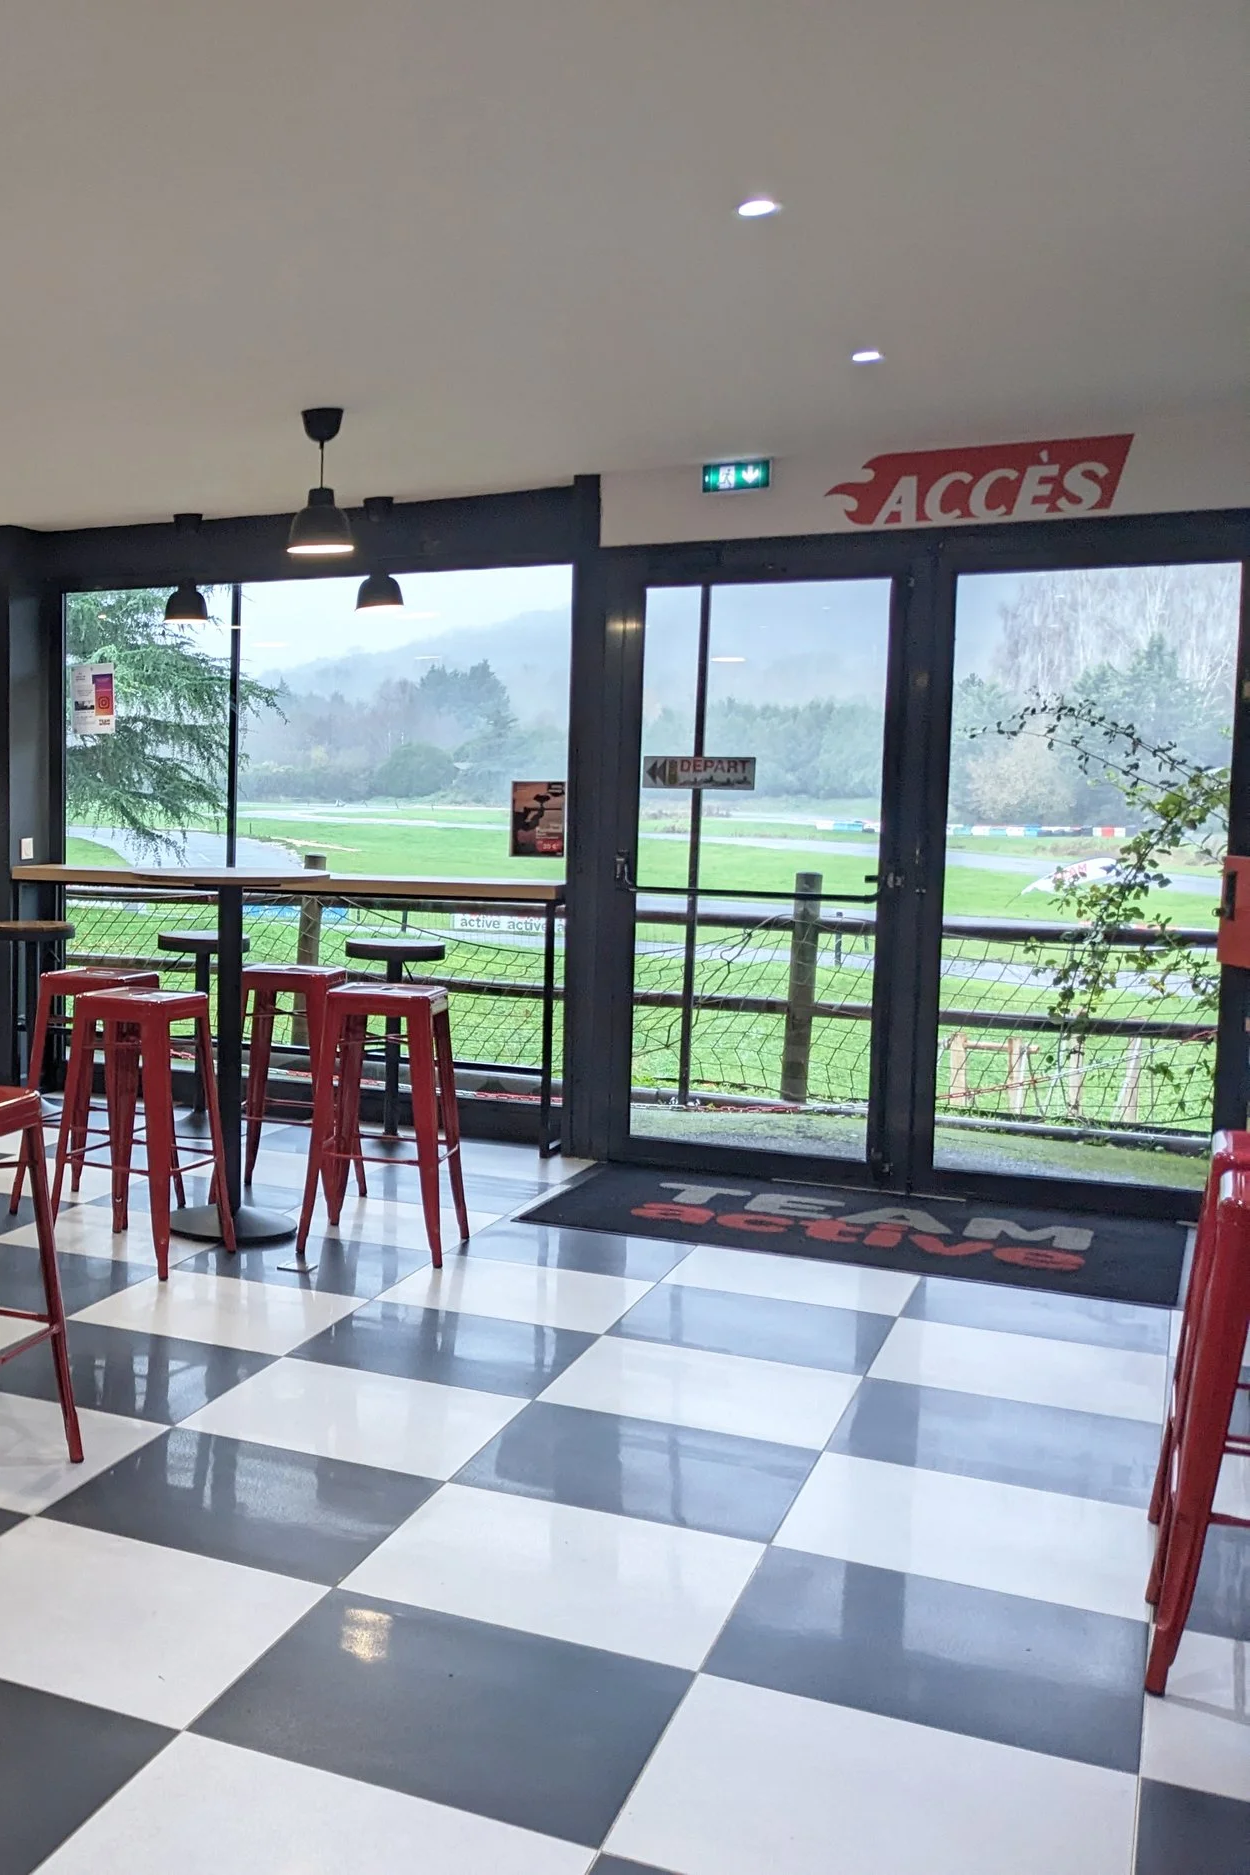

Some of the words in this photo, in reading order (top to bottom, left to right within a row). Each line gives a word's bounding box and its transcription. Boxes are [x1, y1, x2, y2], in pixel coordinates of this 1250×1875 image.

[872, 450, 1111, 527] ACCÈS
[460, 914, 501, 929] active
[630, 1202, 1086, 1272] active
[659, 1182, 1095, 1251] TEAM
